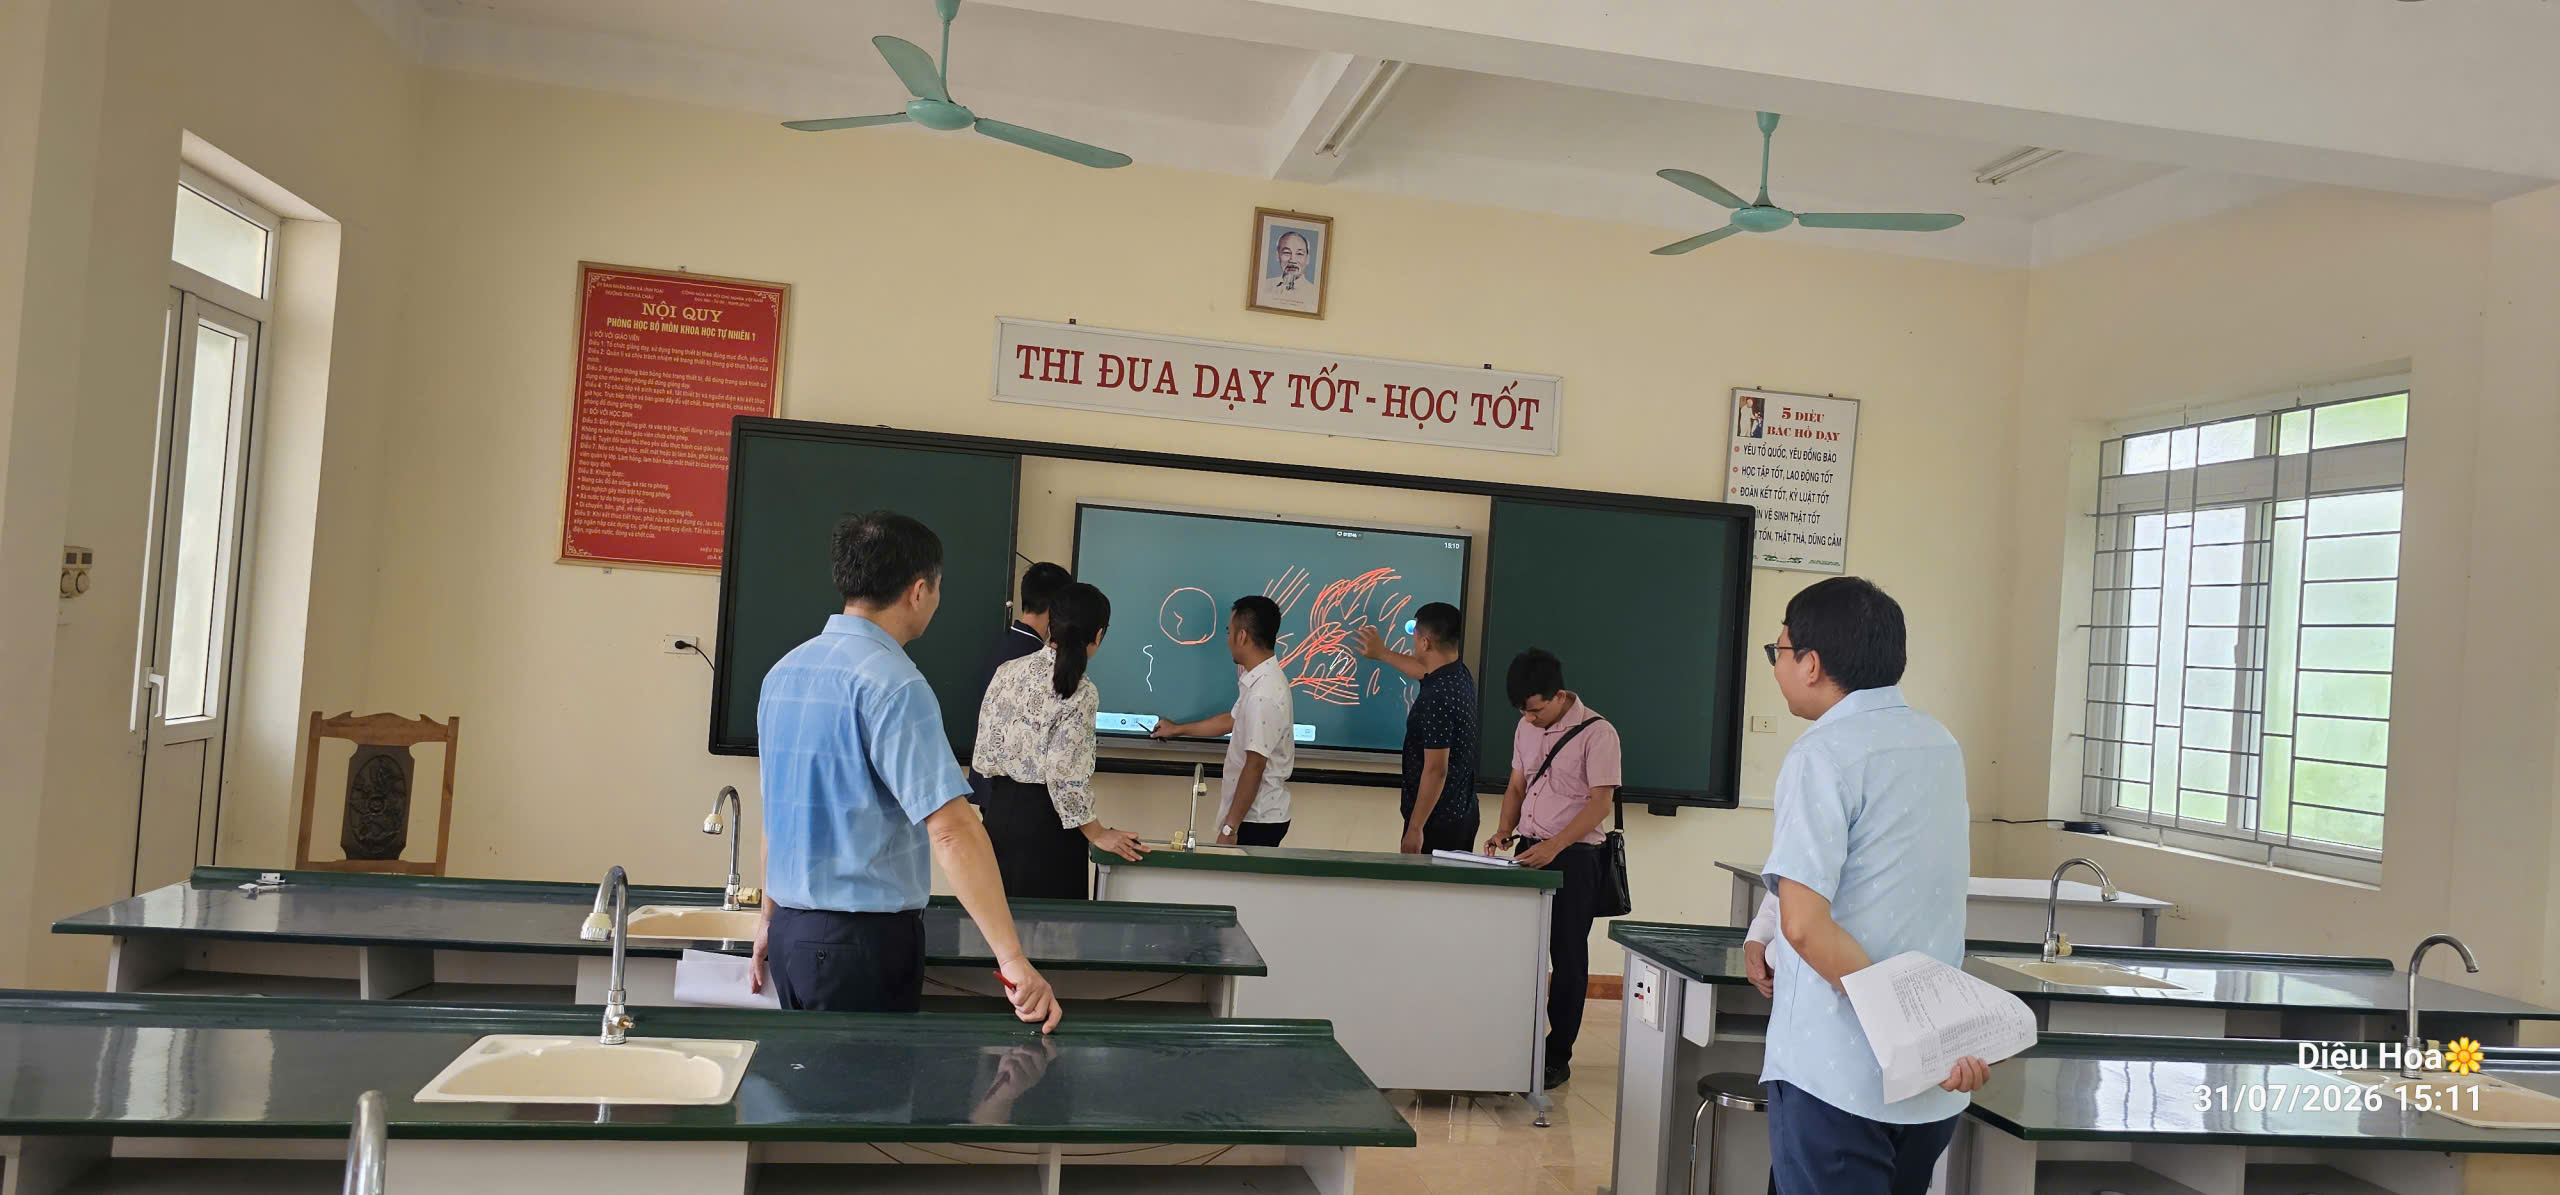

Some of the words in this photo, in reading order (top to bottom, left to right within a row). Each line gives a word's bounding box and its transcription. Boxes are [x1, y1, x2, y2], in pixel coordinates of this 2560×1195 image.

[641, 300, 677, 320] NỘI
[682, 306, 723, 323] QUY
[607, 315, 632, 328] PHÒNG
[633, 319, 648, 332] HỌC
[649, 319, 660, 333] BỘ
[661, 320, 679, 333] MÔN
[680, 324, 700, 335] KHOA
[701, 326, 716, 339] HỌC
[717, 327, 727, 340] TỰ
[728, 328, 750, 341] NHIÊN
[751, 332, 755, 341] 1
[1016, 344, 1084, 385] THI
[1097, 353, 1179, 396] ĐUA
[1192, 364, 1274, 411] DẠY
[1288, 362, 1360, 413] TỐT
[1382, 384, 1458, 430] HỌC
[1470, 380, 1539, 431] TỐT
[1781, 408, 1791, 419] 5
[1767, 424, 1791, 436] BÁC
[1794, 425, 1812, 439] HỒ
[1816, 430, 1840, 443] DẠY
[1744, 443, 1756, 456] YÊU
[1757, 442, 1766, 456] TỔ
[1767, 444, 1788, 459] QUỐC,
[1789, 447, 1802, 460] YÊU
[1803, 447, 1821, 462] ĐỒNG
[1823, 450, 1837, 463] BÀO
[1742, 466, 1755, 478] HỌC
[1757, 465, 1769, 480] TẬP
[1771, 465, 1785, 480] TỐT,
[1786, 470, 1799, 480] LAO
[1800, 469, 1819, 483] ĐỘNG
[1821, 470, 1833, 483] TỐT
[1740, 485, 1758, 497] ĐOÀN
[1760, 485, 1772, 499] KẾT
[1774, 486, 1788, 502] TỐT,
[1799, 491, 1816, 505] LUẬT
[1817, 490, 1829, 504] TỐT
[1764, 508, 1772, 522] VỆ
[1774, 511, 1788, 521] SINH
[1790, 510, 1806, 525] THẬT
[1808, 510, 1820, 524] TỐT
